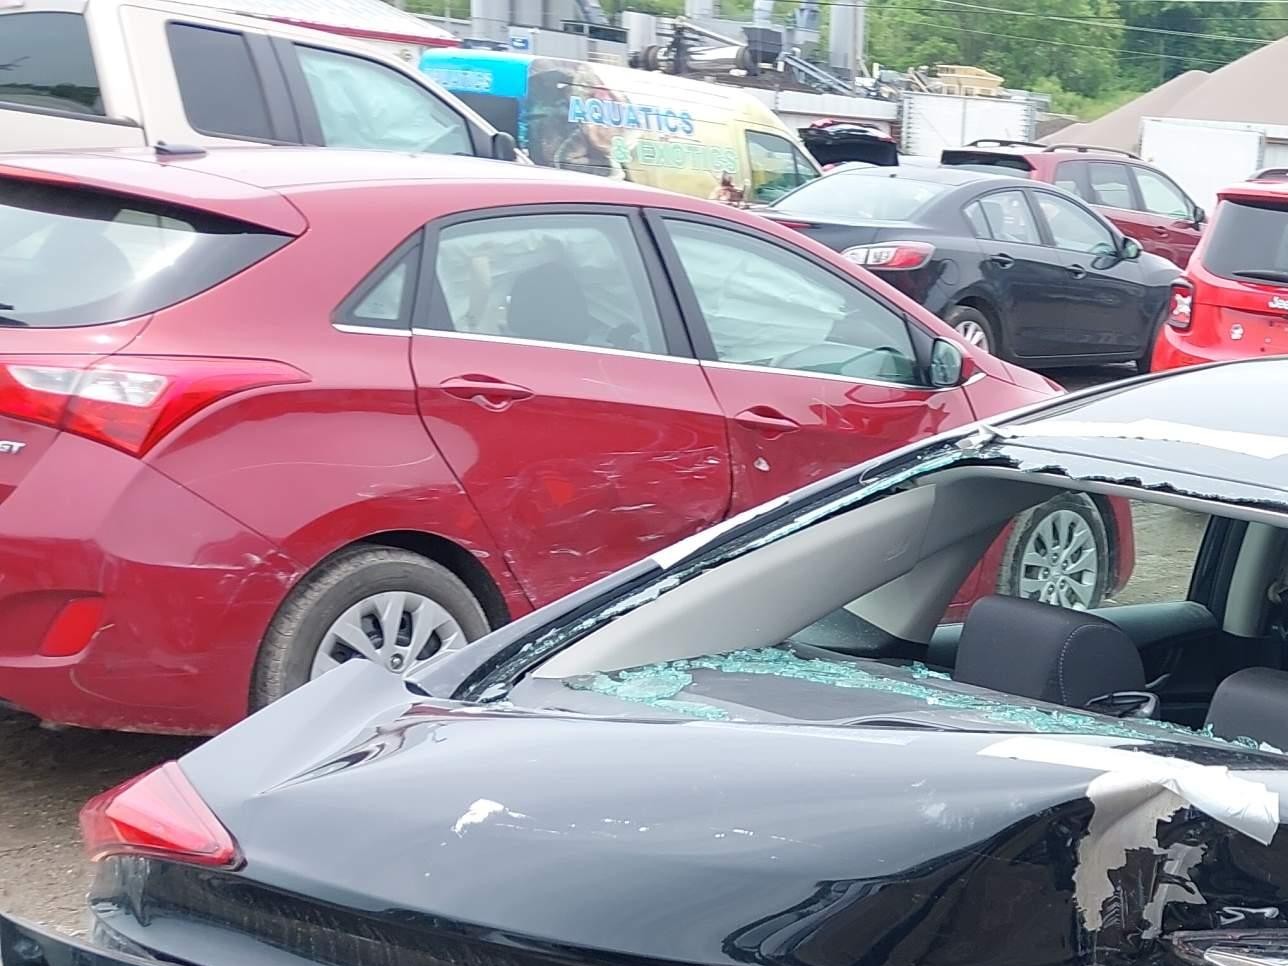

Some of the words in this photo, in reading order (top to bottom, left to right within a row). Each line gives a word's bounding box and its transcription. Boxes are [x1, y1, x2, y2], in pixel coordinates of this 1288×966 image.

[568, 96, 694, 135] AQUATICS
[612, 136, 632, 163] &
[637, 138, 738, 173] EXOTICS
